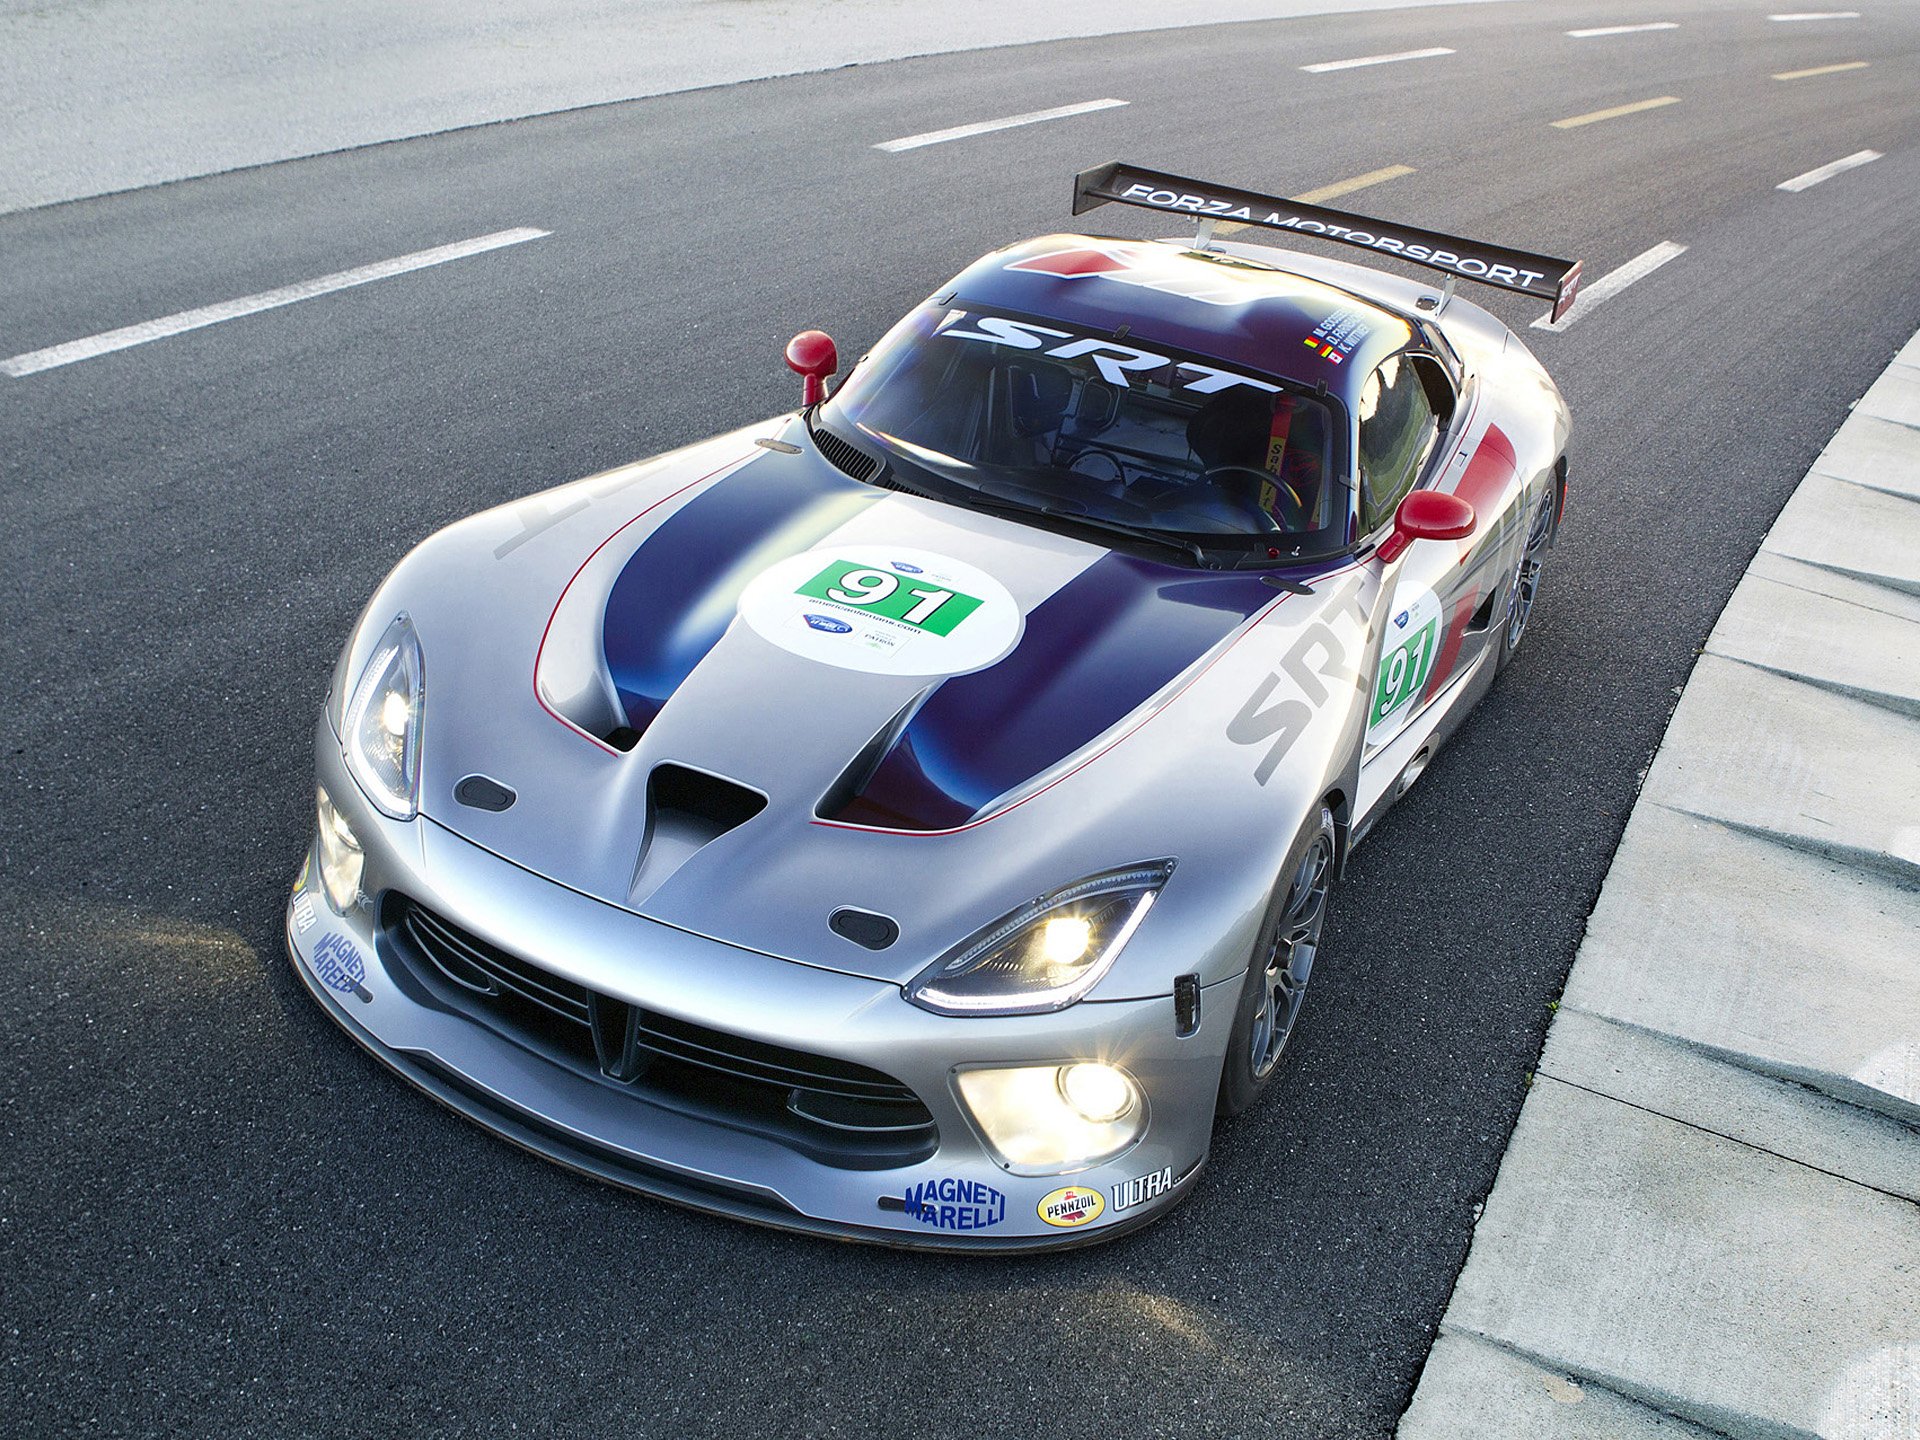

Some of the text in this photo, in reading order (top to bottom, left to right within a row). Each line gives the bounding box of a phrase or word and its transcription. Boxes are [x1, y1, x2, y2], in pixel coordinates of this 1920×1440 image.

[1121, 183, 1546, 288] FORZA MOTORSPORT
[941, 317, 1284, 394] SRT
[824, 568, 957, 626] 91
[1226, 575, 1375, 787] SRT
[1379, 628, 1428, 717] 91
[292, 887, 318, 936] ULTRA
[313, 932, 367, 986] MAGNETI
[905, 1178, 1005, 1210] MAGNETI
[905, 1201, 1005, 1230] MARELLI
[1046, 1194, 1096, 1219] PENNZOIL
[1111, 1166, 1173, 1212] ULTRA
